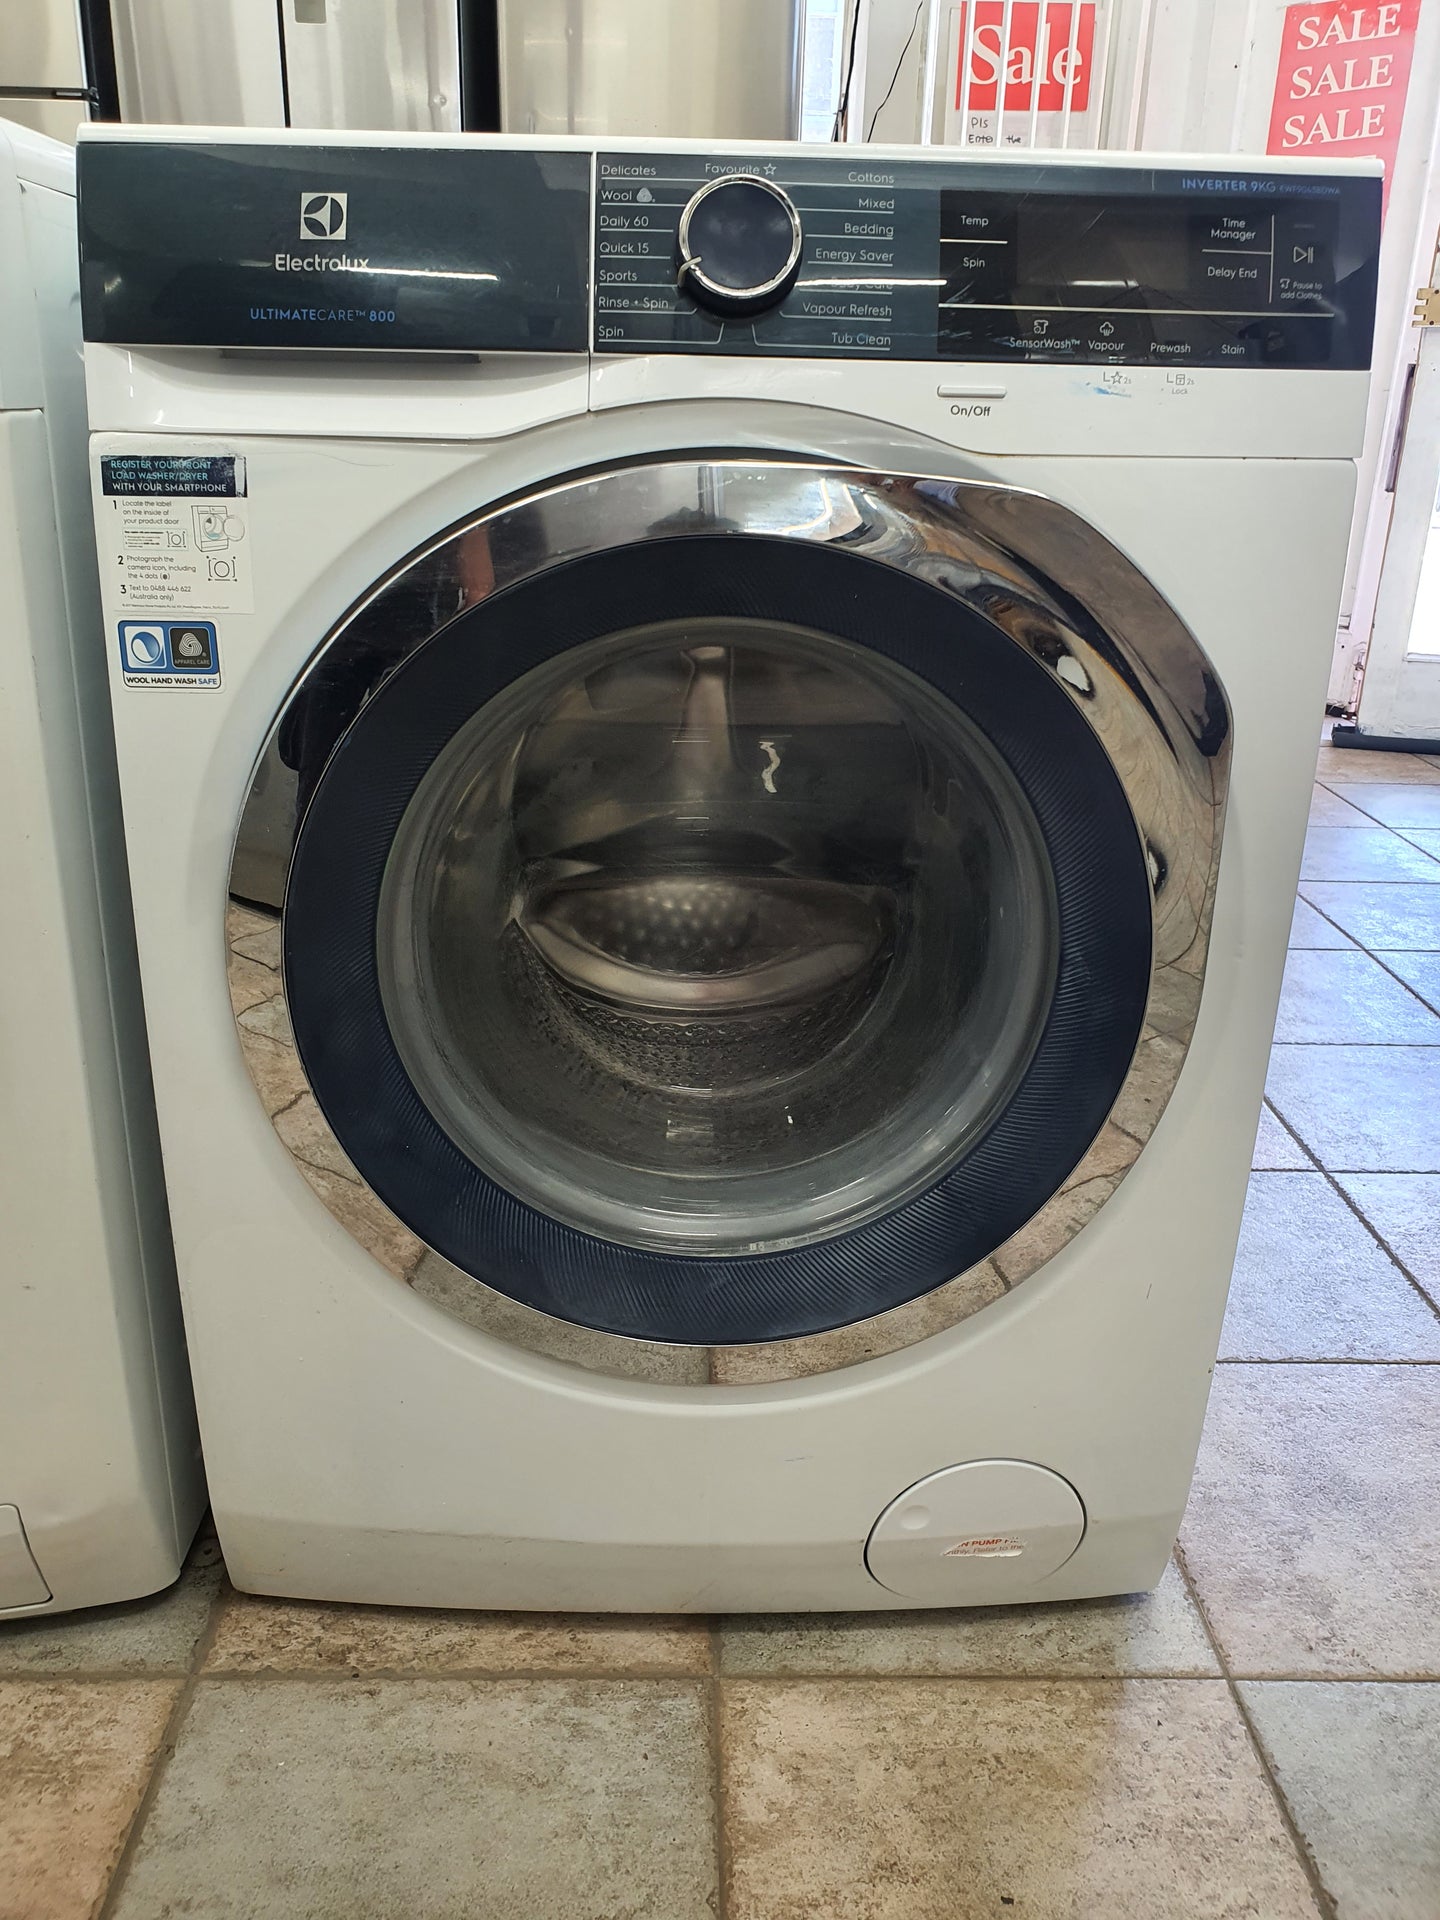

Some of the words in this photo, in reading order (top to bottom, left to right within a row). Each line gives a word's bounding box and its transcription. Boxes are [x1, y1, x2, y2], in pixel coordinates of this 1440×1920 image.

[1297, 3, 1401, 51] SALE
[969, 23, 1083, 86] Sale
[1290, 54, 1394, 100] SALE
[1282, 104, 1386, 148] SALE
[601, 164, 656, 176] Delicates
[705, 163, 760, 175] Favourite
[848, 171, 895, 184] Cottons
[1182, 178, 1247, 192] INVERTER
[1250, 180, 1276, 193] 9KG
[600, 190, 632, 201] Wool
[858, 198, 895, 210] Mixed
[600, 215, 630, 229] Daily
[633, 216, 649, 227] 60
[960, 214, 989, 228] Temp
[1222, 217, 1246, 229] Time
[844, 222, 894, 237] Bedding
[1210, 228, 1256, 242] Manager
[599, 242, 634, 254] Quick
[637, 242, 649, 254] 15
[815, 247, 856, 263] Energy
[859, 249, 895, 262] Saver
[275, 253, 369, 272] Electrolux
[963, 256, 986, 270] Spin
[599, 269, 638, 283] Sports
[1207, 266, 1236, 280] Delay
[1238, 267, 1258, 279] End
[1280, 291, 1296, 300] add
[598, 296, 630, 308] Rinse
[642, 297, 669, 311] Spin
[802, 302, 846, 316] Vapour
[849, 303, 892, 317] Refresh
[369, 310, 396, 322] 800
[598, 325, 624, 339] Spin
[831, 332, 853, 345] Tub
[856, 333, 891, 346] Clean
[1088, 340, 1125, 352] Vapour
[1150, 342, 1191, 354] Prewash
[1221, 343, 1246, 356] Stain
[950, 405, 991, 418] On/Off
[111, 459, 151, 469] REGISTER
[154, 460, 178, 469] YOUR
[111, 470, 136, 480] LOAD
[138, 471, 209, 481] WASHER/DRYER
[112, 482, 136, 491] WITH
[137, 482, 163, 492] YOUR
[165, 483, 227, 493] SMARTPHONE
[112, 500, 117, 510] 1
[122, 499, 144, 507] Locate
[138, 517, 163, 525] product
[117, 555, 124, 565] 2
[126, 555, 163, 563] Photograph
[168, 565, 197, 573] including
[120, 584, 127, 594] 3
[129, 584, 141, 592] Text
[126, 676, 150, 684] WOOL
[174, 677, 197, 685] WASH
[971, 1538, 1003, 1547] PUMP
